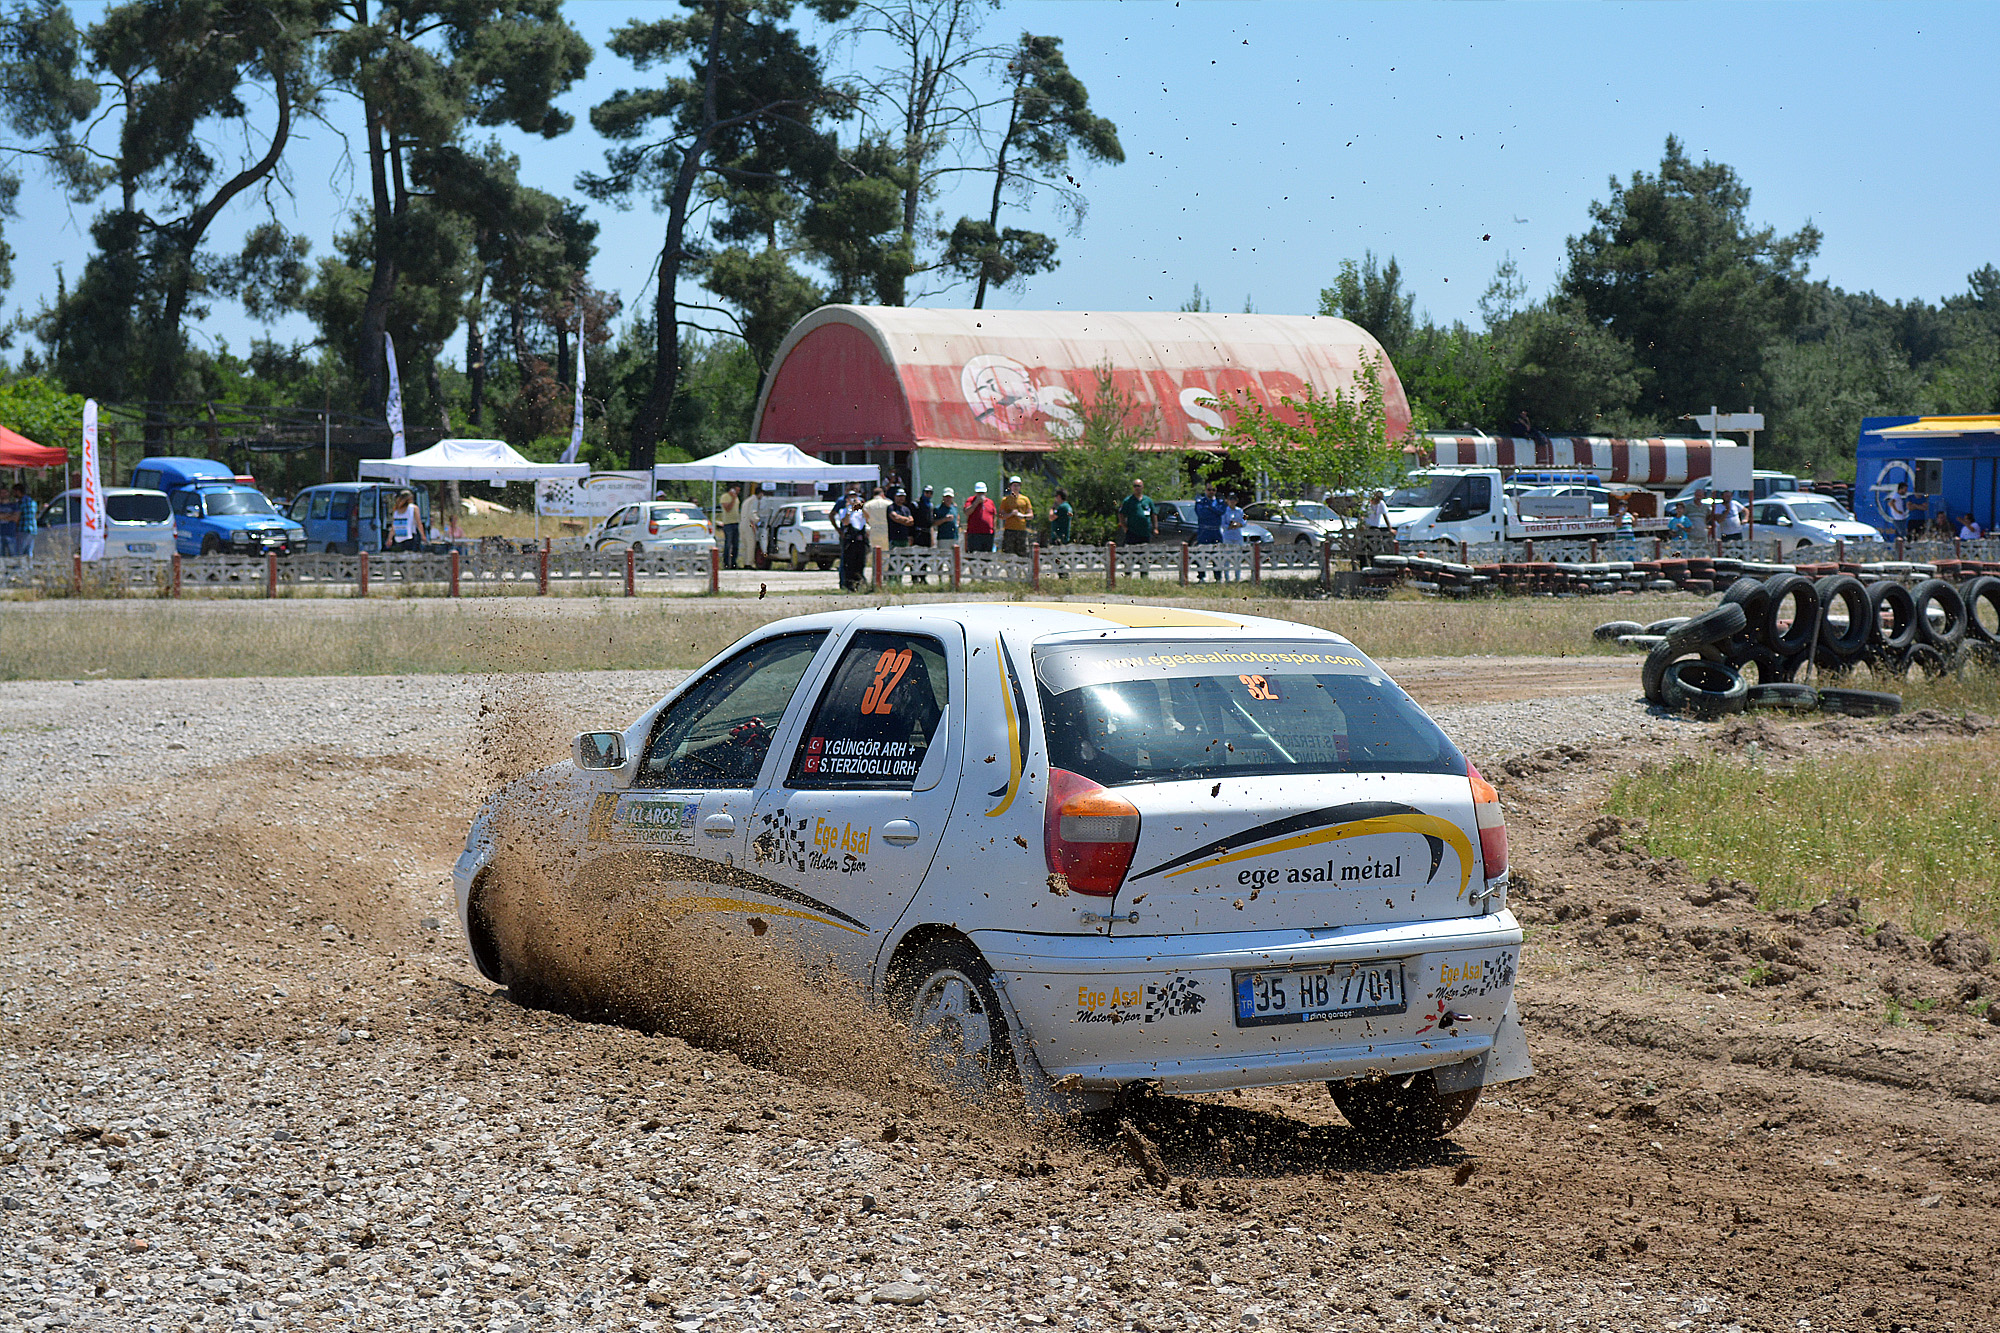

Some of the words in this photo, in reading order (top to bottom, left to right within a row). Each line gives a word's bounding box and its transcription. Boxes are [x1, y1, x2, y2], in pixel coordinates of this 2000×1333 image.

[1092, 651, 1366, 670] www.egeasalmotorspor.com
[861, 648, 913, 715] 32
[1239, 674, 1280, 700] 32
[824, 738, 879, 756] Y.GÜNGÖR
[881, 741, 908, 757] ARH
[630, 807, 679, 825] KLAROS
[814, 817, 838, 854] Ege
[841, 822, 872, 854] Asal
[809, 850, 838, 870] Motor
[842, 854, 867, 876] Spor
[1238, 869, 1280, 890] ege
[1287, 860, 1334, 883] asal
[1341, 855, 1401, 881] metal
[1440, 963, 1460, 988] Ege
[1461, 960, 1483, 981] Asal
[1078, 986, 1107, 1012] Ege
[1110, 984, 1143, 1006] Asal
[1255, 976, 1287, 1012] 35
[1300, 974, 1329, 1008] HB
[1341, 969, 1395, 1005] 7701
[1241, 1000, 1254, 1010] TR
